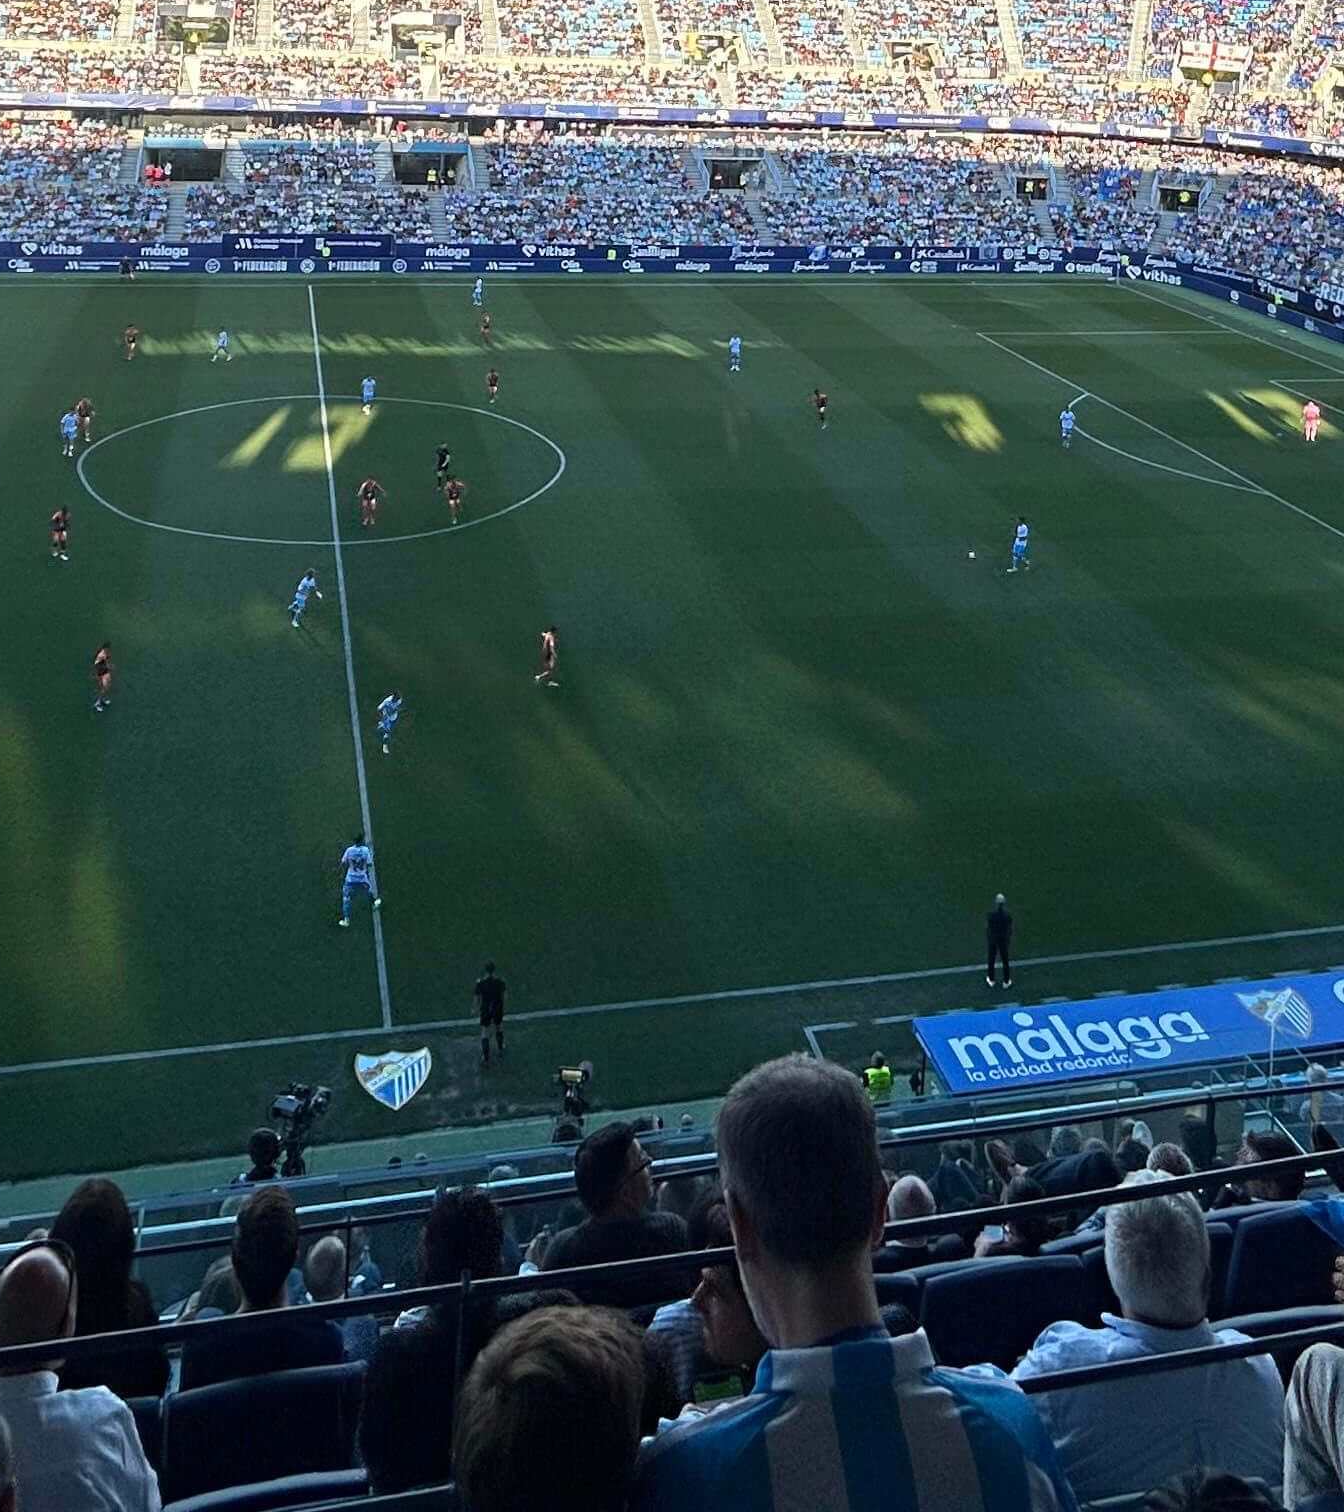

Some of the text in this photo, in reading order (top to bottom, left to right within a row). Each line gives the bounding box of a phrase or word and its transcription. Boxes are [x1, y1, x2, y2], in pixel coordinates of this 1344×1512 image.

[40, 242, 83, 256] vithas
[140, 244, 189, 259] málaga
[425, 245, 470, 259] málaga
[539, 243, 576, 257] vithas
[1143, 268, 1182, 286] vithas
[947, 1011, 1211, 1069] málaga
[965, 1052, 1134, 1083] la ciudad redonda
